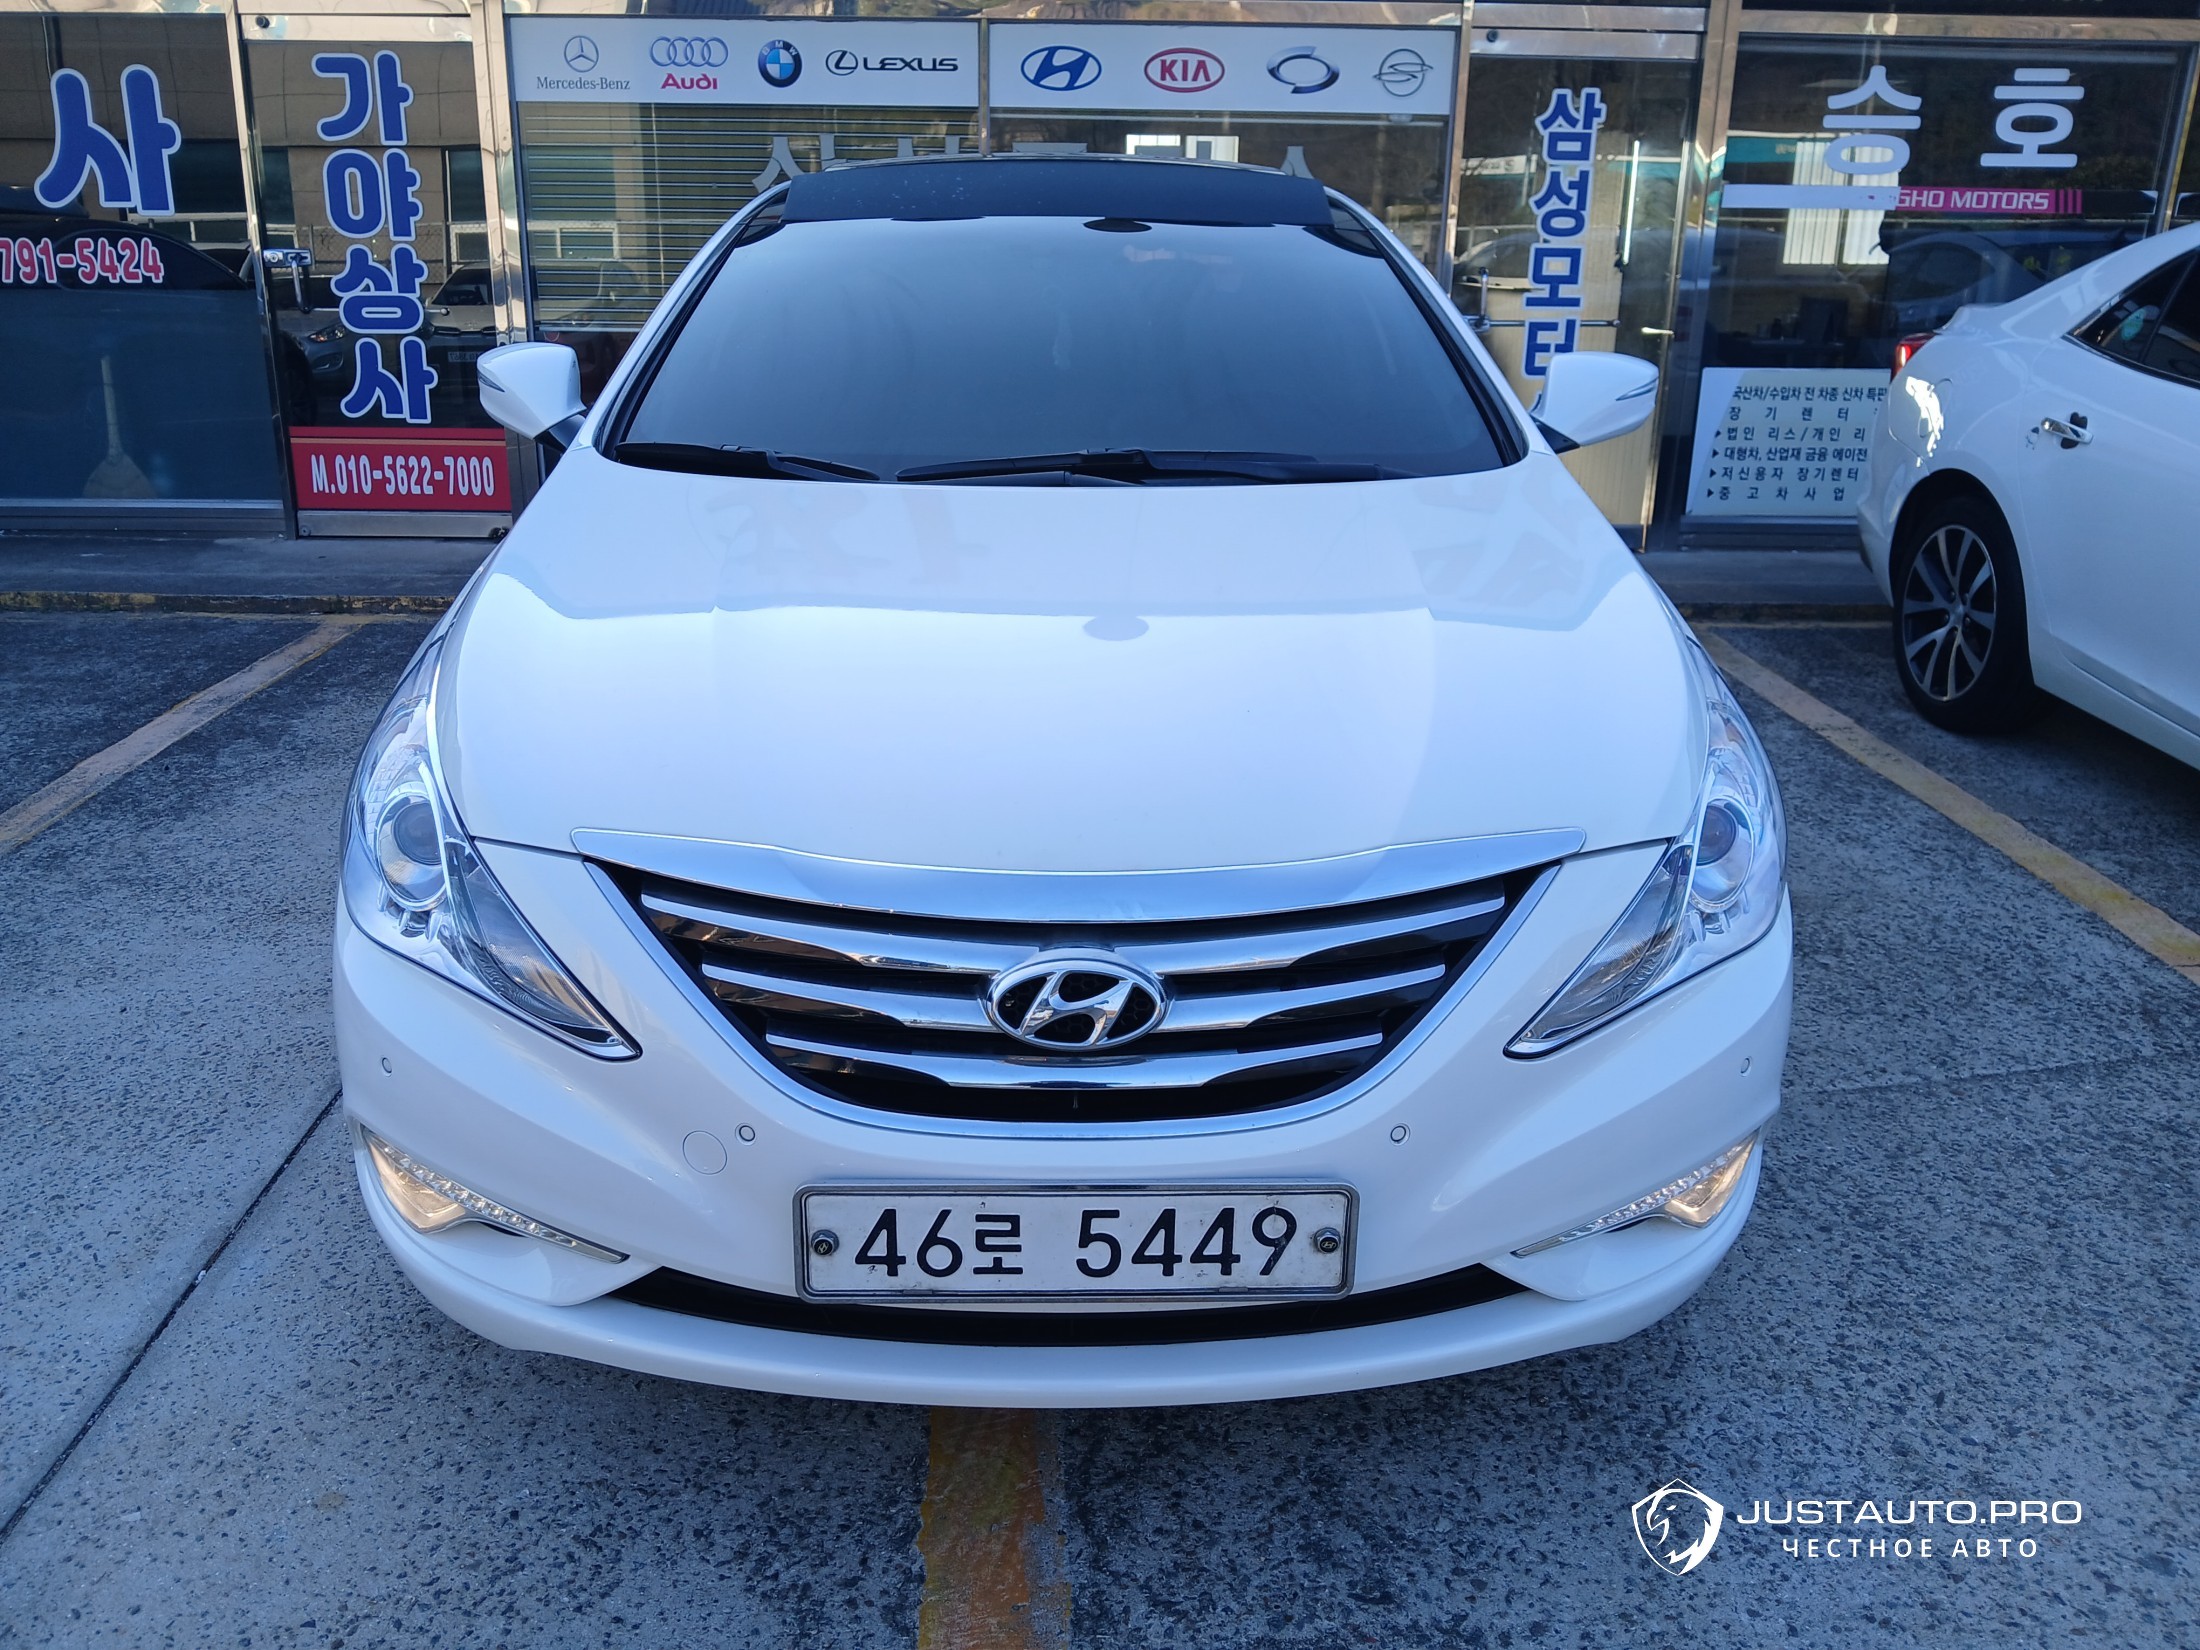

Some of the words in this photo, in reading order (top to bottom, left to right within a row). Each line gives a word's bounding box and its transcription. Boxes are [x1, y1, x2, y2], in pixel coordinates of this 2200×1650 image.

[760, 39, 799, 57] BMW
[863, 56, 958, 72] LEXUS
[1160, 59, 1212, 82] KIA
[536, 76, 630, 91] Mercedes-Benz
[660, 72, 718, 90] Audi
[34, 64, 181, 216] 사
[1950, 191, 2050, 211] MOTORS
[311, 49, 438, 425] 가야상사
[1522, 87, 1607, 400] 삼성모터
[0, 237, 164, 284] 791-5424
[1804, 387, 1815, 401] 전
[1818, 387, 1838, 401] 차종
[1841, 387, 1864, 402] 신차
[1805, 448, 1828, 462] 금융
[310, 454, 495, 496] M.010-5622-7000
[854, 1208, 1025, 1278] 46로
[1075, 1207, 1298, 1278] 5449
